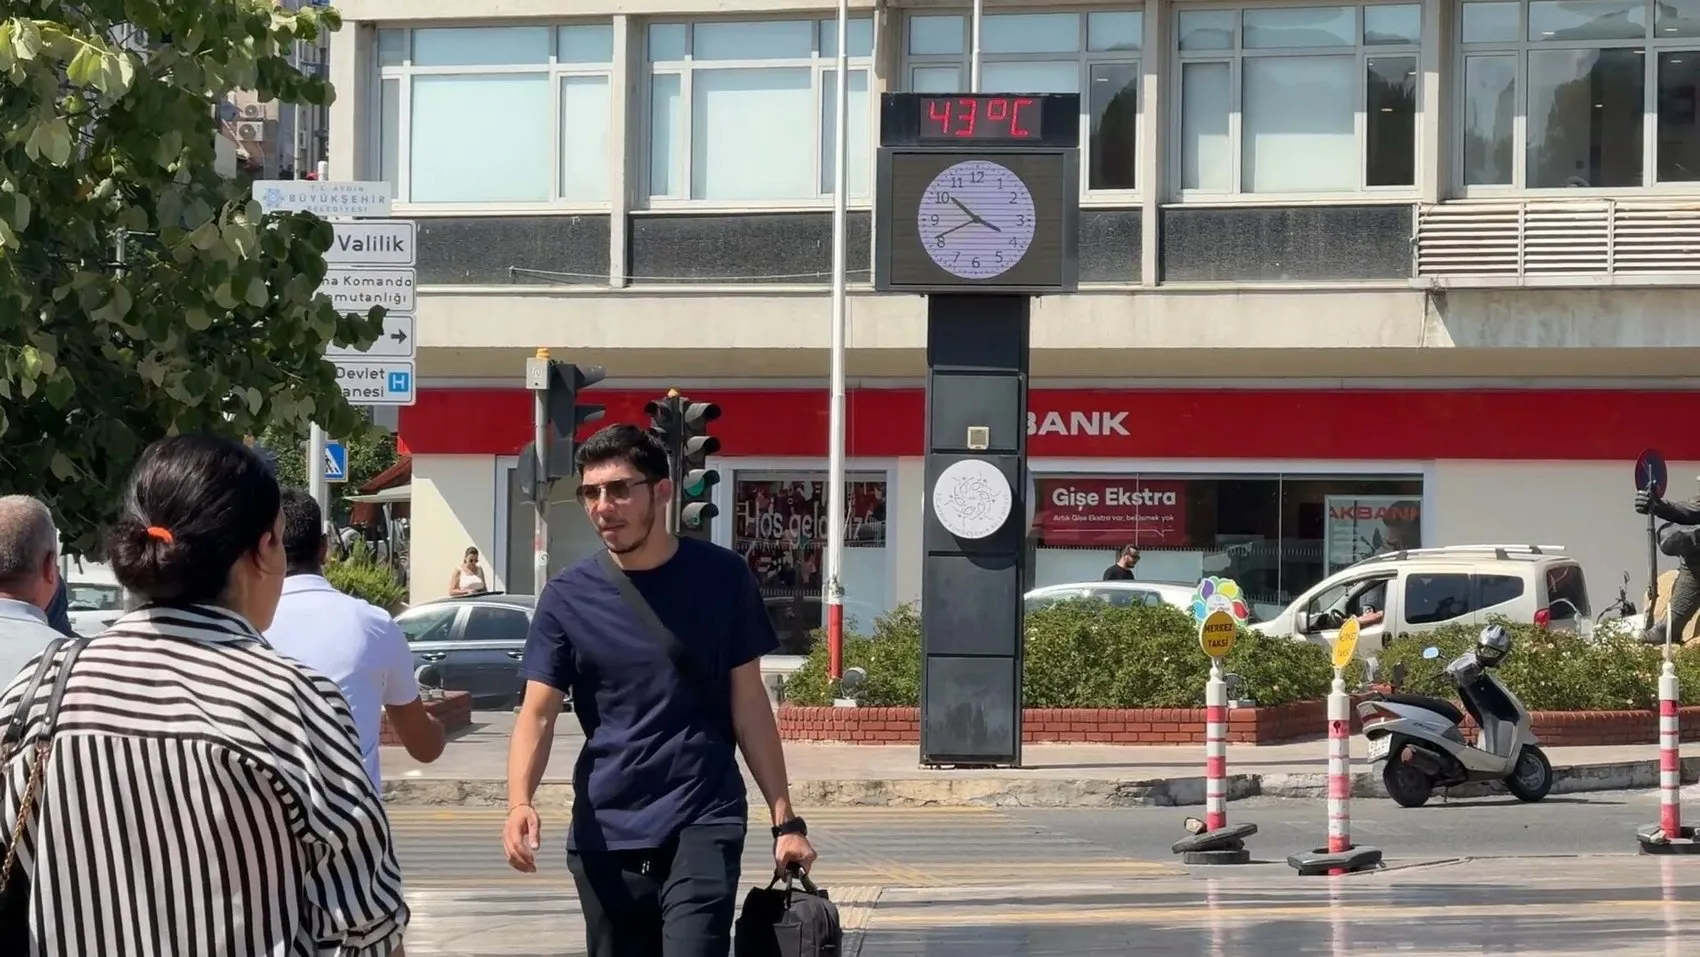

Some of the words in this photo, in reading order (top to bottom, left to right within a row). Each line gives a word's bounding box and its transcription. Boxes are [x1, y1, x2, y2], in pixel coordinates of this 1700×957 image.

[951, 177, 964, 189] 11
[969, 171, 985, 184] 12
[997, 178, 1004, 189] 1
[289, 193, 385, 205] BÜYÜKŞEHİR
[935, 191, 950, 204] 10
[1009, 191, 1018, 204] 2
[930, 214, 940, 226] 9
[1015, 214, 1025, 227] 3
[337, 234, 405, 252] Valilik
[936, 235, 946, 248] 8
[1008, 236, 1018, 248] 4
[952, 252, 961, 263] 7
[971, 257, 980, 268] 6
[995, 251, 1003, 263] 5
[343, 275, 412, 287] Komando
[336, 366, 385, 379] Devlet
[1052, 486, 1099, 511] Gişe
[1105, 487, 1177, 506] Ekstra
[1205, 623, 1233, 633] MERKEZ
